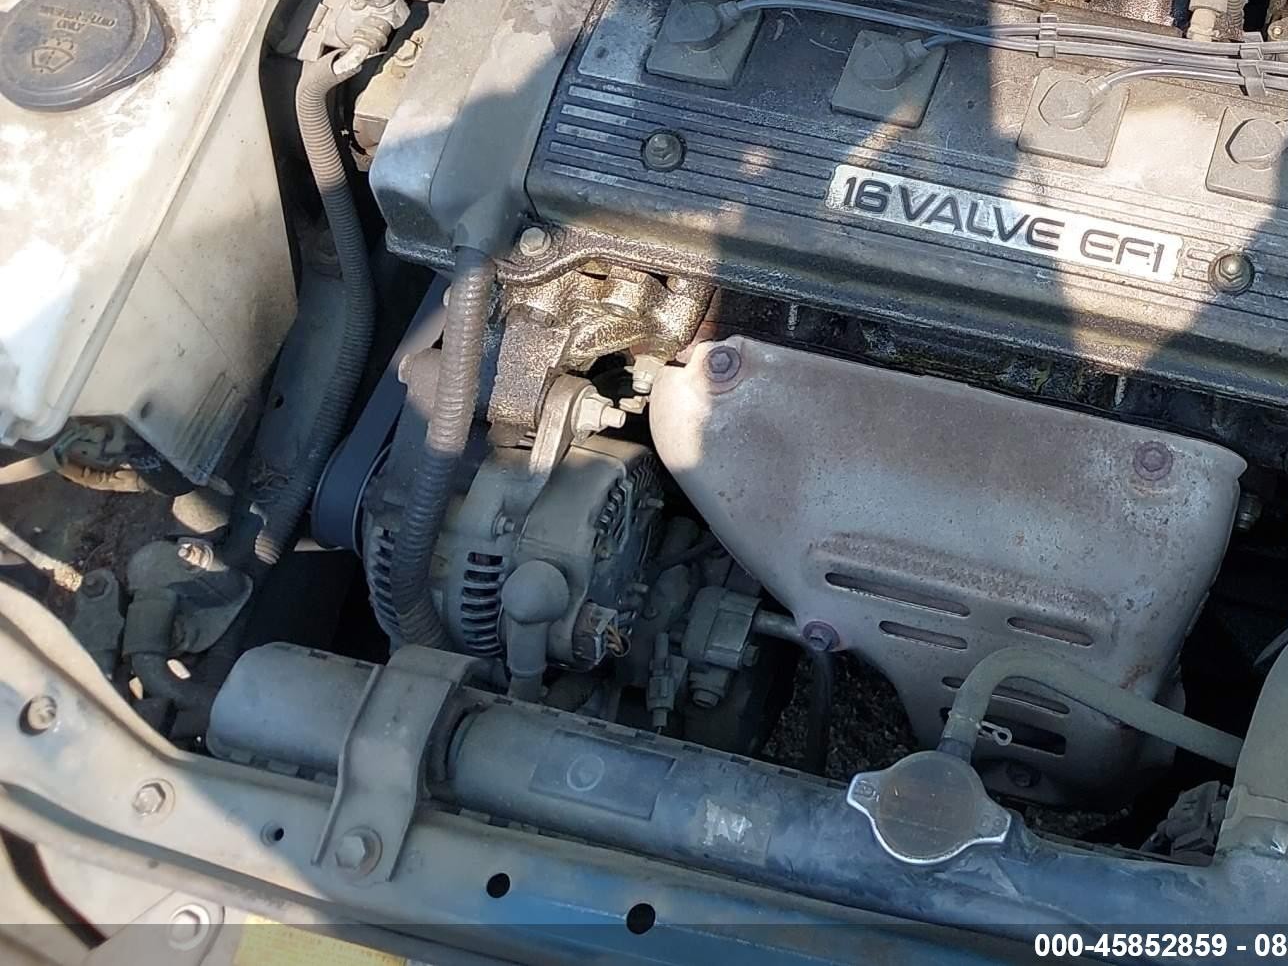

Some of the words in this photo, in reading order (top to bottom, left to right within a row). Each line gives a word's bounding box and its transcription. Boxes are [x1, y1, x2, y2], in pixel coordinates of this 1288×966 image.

[843, 176, 892, 213] 16
[898, 183, 1067, 251] VALVE
[1080, 228, 1165, 273] EFI
